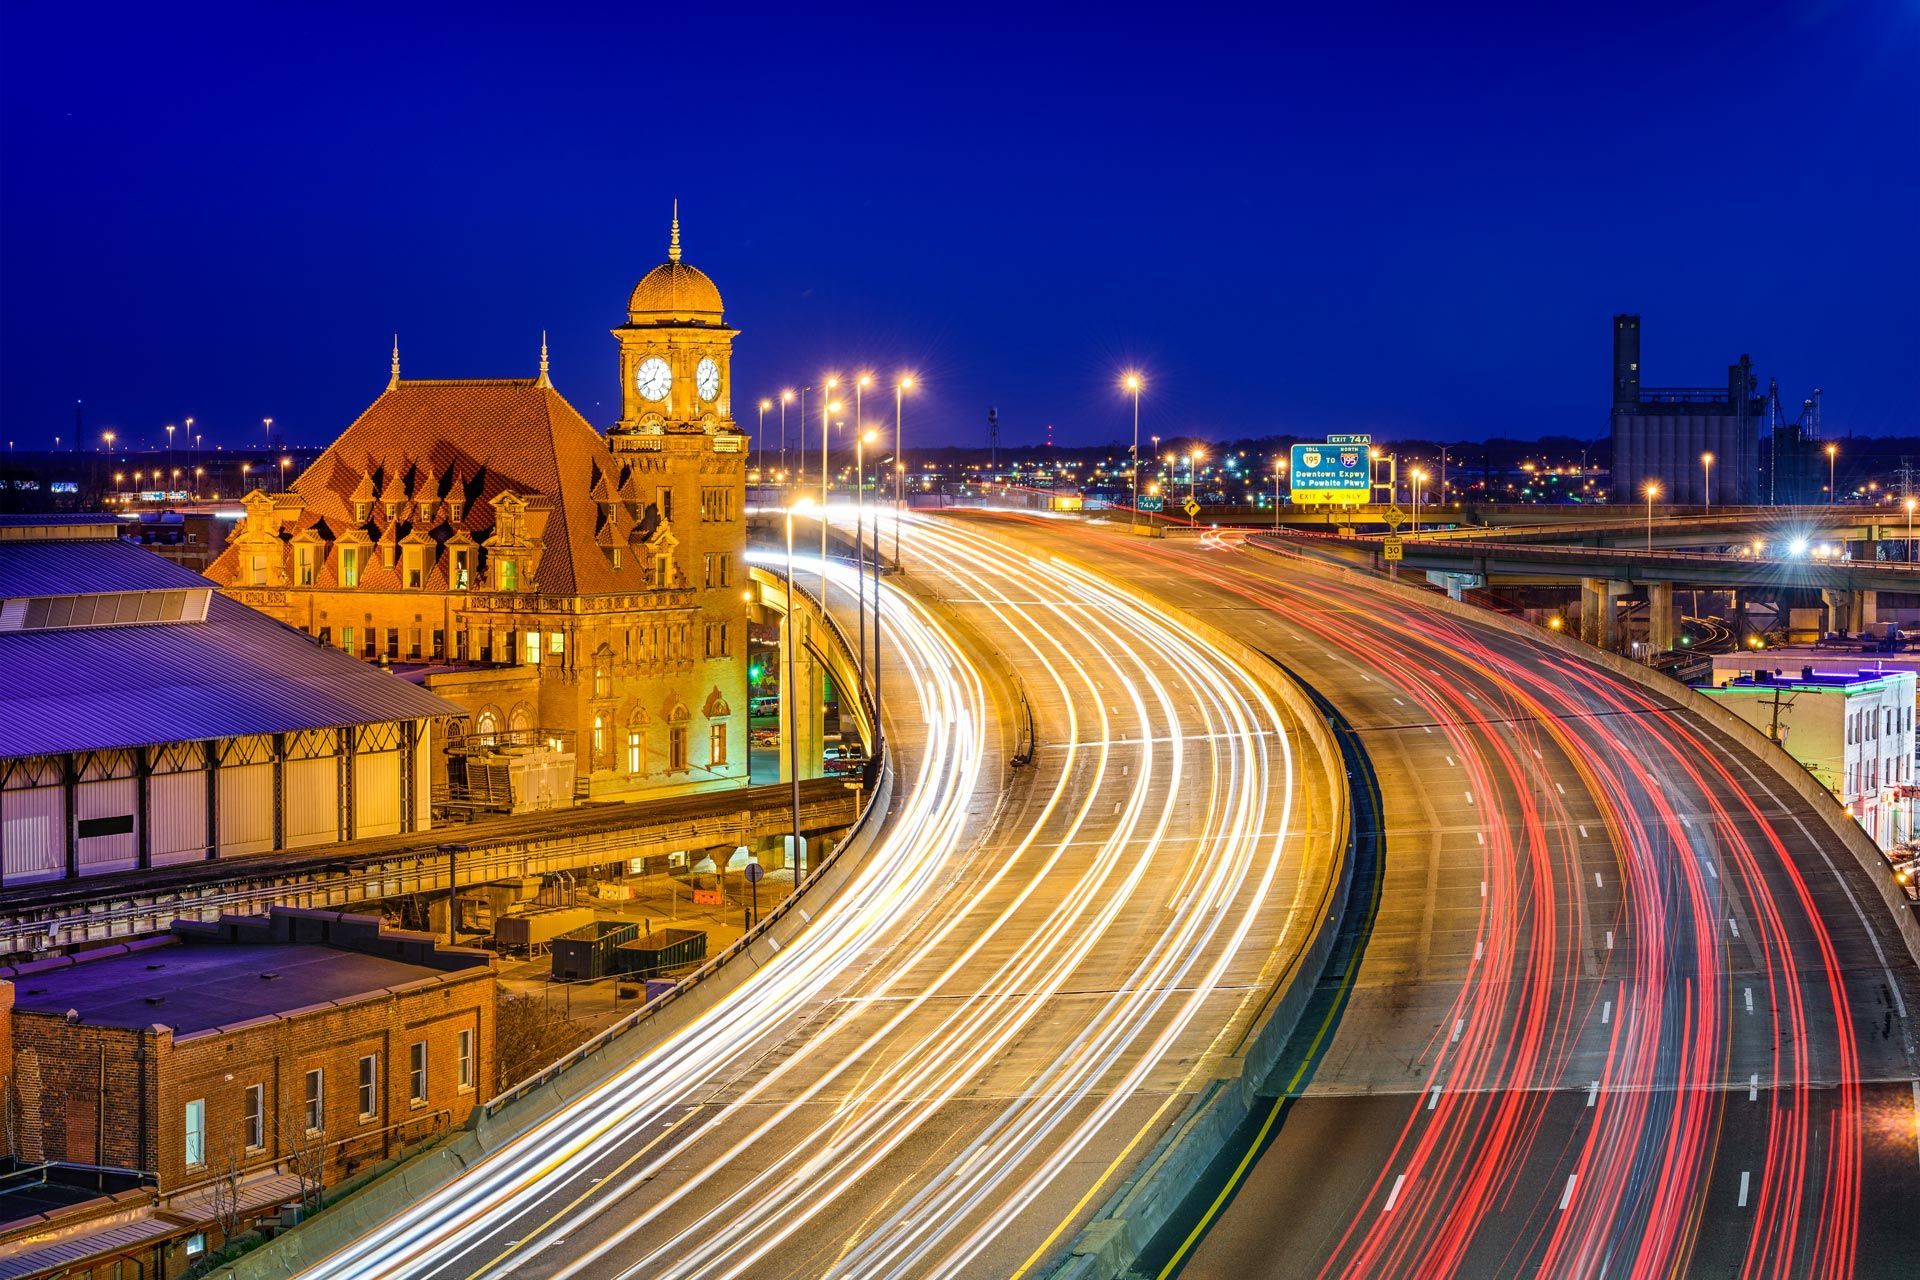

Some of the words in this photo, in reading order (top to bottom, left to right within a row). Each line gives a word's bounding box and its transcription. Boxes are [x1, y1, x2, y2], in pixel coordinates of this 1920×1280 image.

[1305, 456, 1319, 464] 195
[1343, 456, 1357, 465] 195
[1339, 471, 1365, 479] Expwy
[1344, 479, 1365, 488] Pkwy
[1387, 546, 1399, 554] 30
